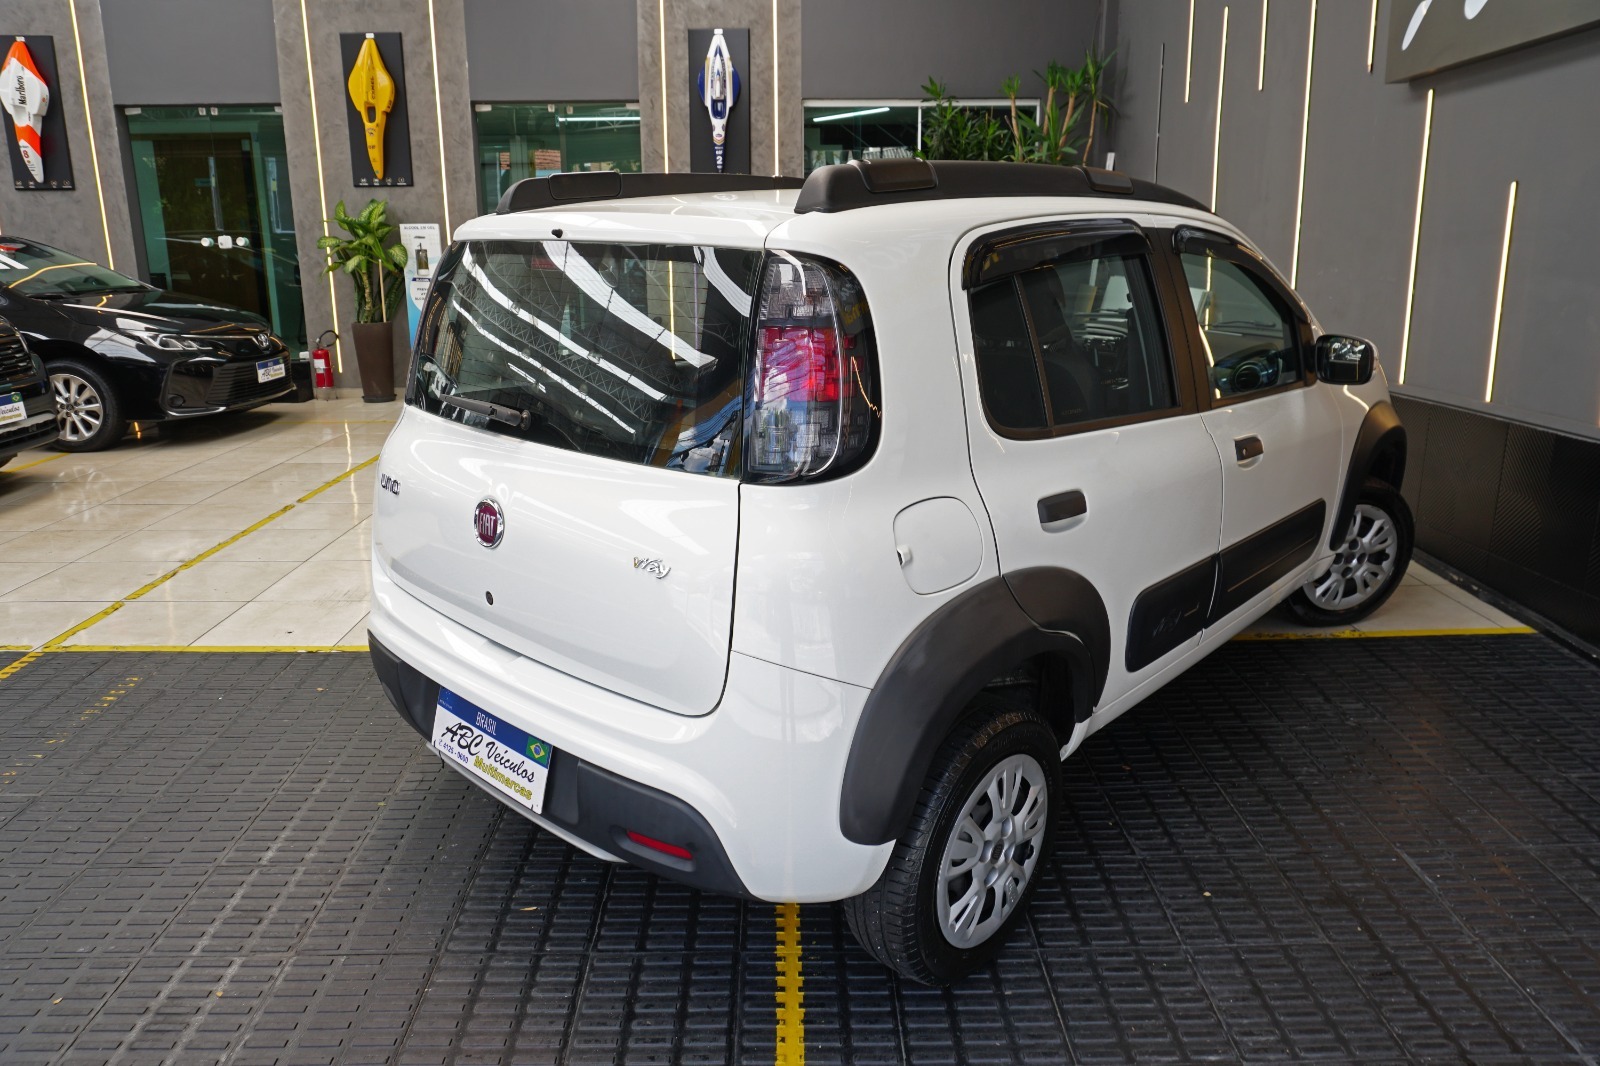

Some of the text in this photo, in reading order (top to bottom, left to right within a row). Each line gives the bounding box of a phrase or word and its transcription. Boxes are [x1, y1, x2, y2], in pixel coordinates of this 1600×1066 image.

[15, 75, 27, 105] Marlboro
[716, 155, 723, 165] 2
[479, 512, 496, 537] FIAT
[475, 711, 497, 736] BRASIL
[441, 722, 484, 756] ABC
[473, 755, 533, 801] Multimarcas
